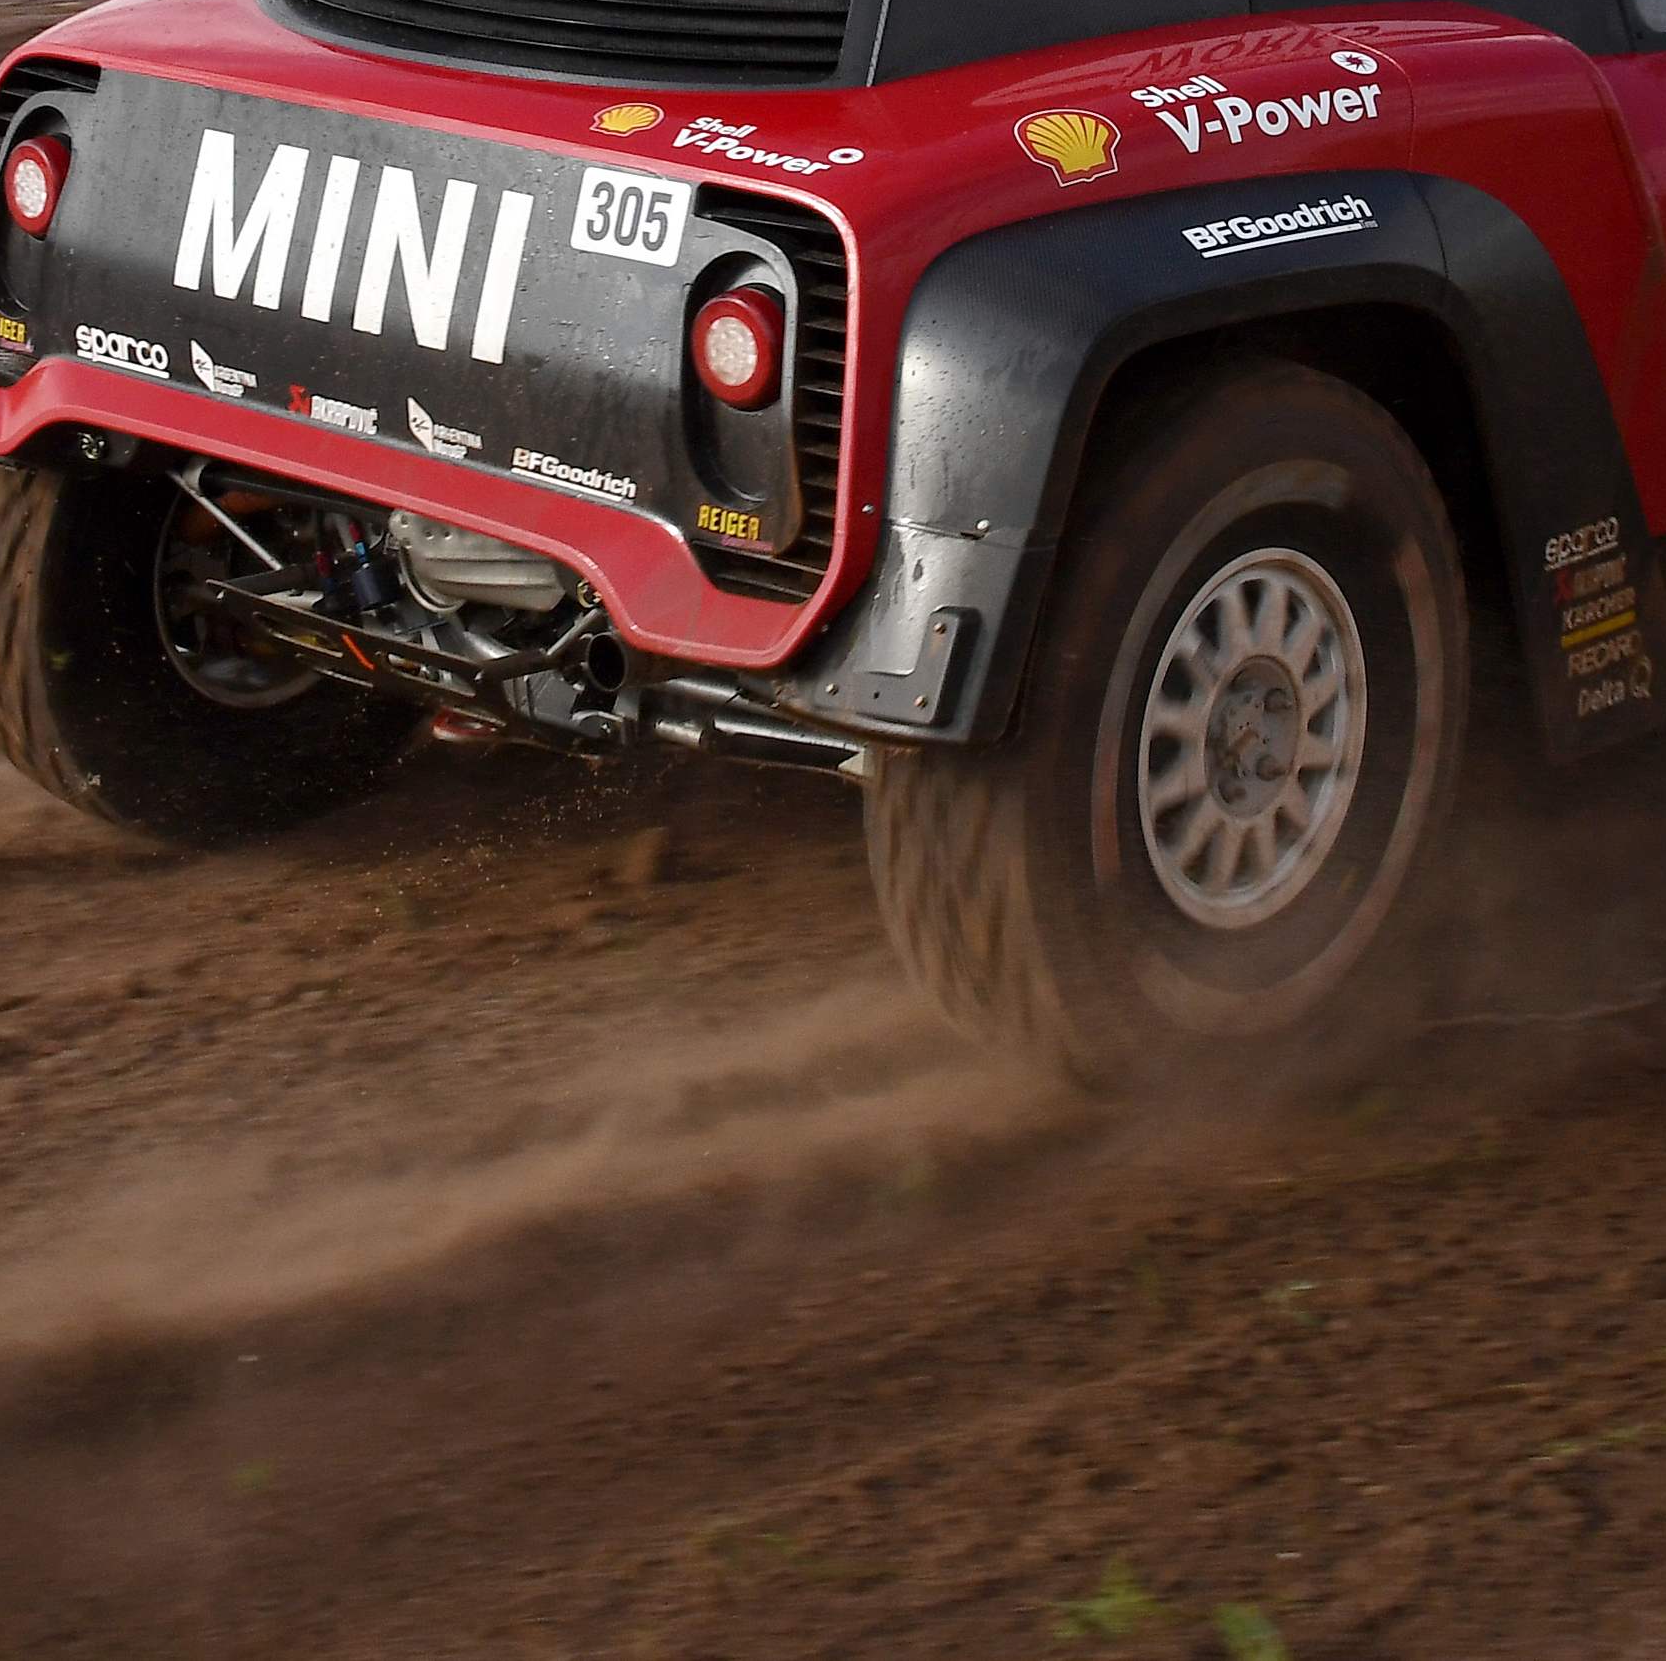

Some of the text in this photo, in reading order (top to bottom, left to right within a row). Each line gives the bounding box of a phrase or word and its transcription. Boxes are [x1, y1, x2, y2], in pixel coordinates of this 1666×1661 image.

[1130, 75, 1228, 109] Shell
[688, 117, 757, 138] Shell
[1155, 84, 1382, 153] V-Power
[673, 129, 831, 175] V-Power
[586, 181, 674, 252] 305
[1182, 194, 1373, 252] BFGoodrich
[173, 129, 534, 366] MINI
[75, 323, 169, 371] sparco
[512, 447, 637, 499] BFGoodrich
[697, 504, 761, 541] REIGER
